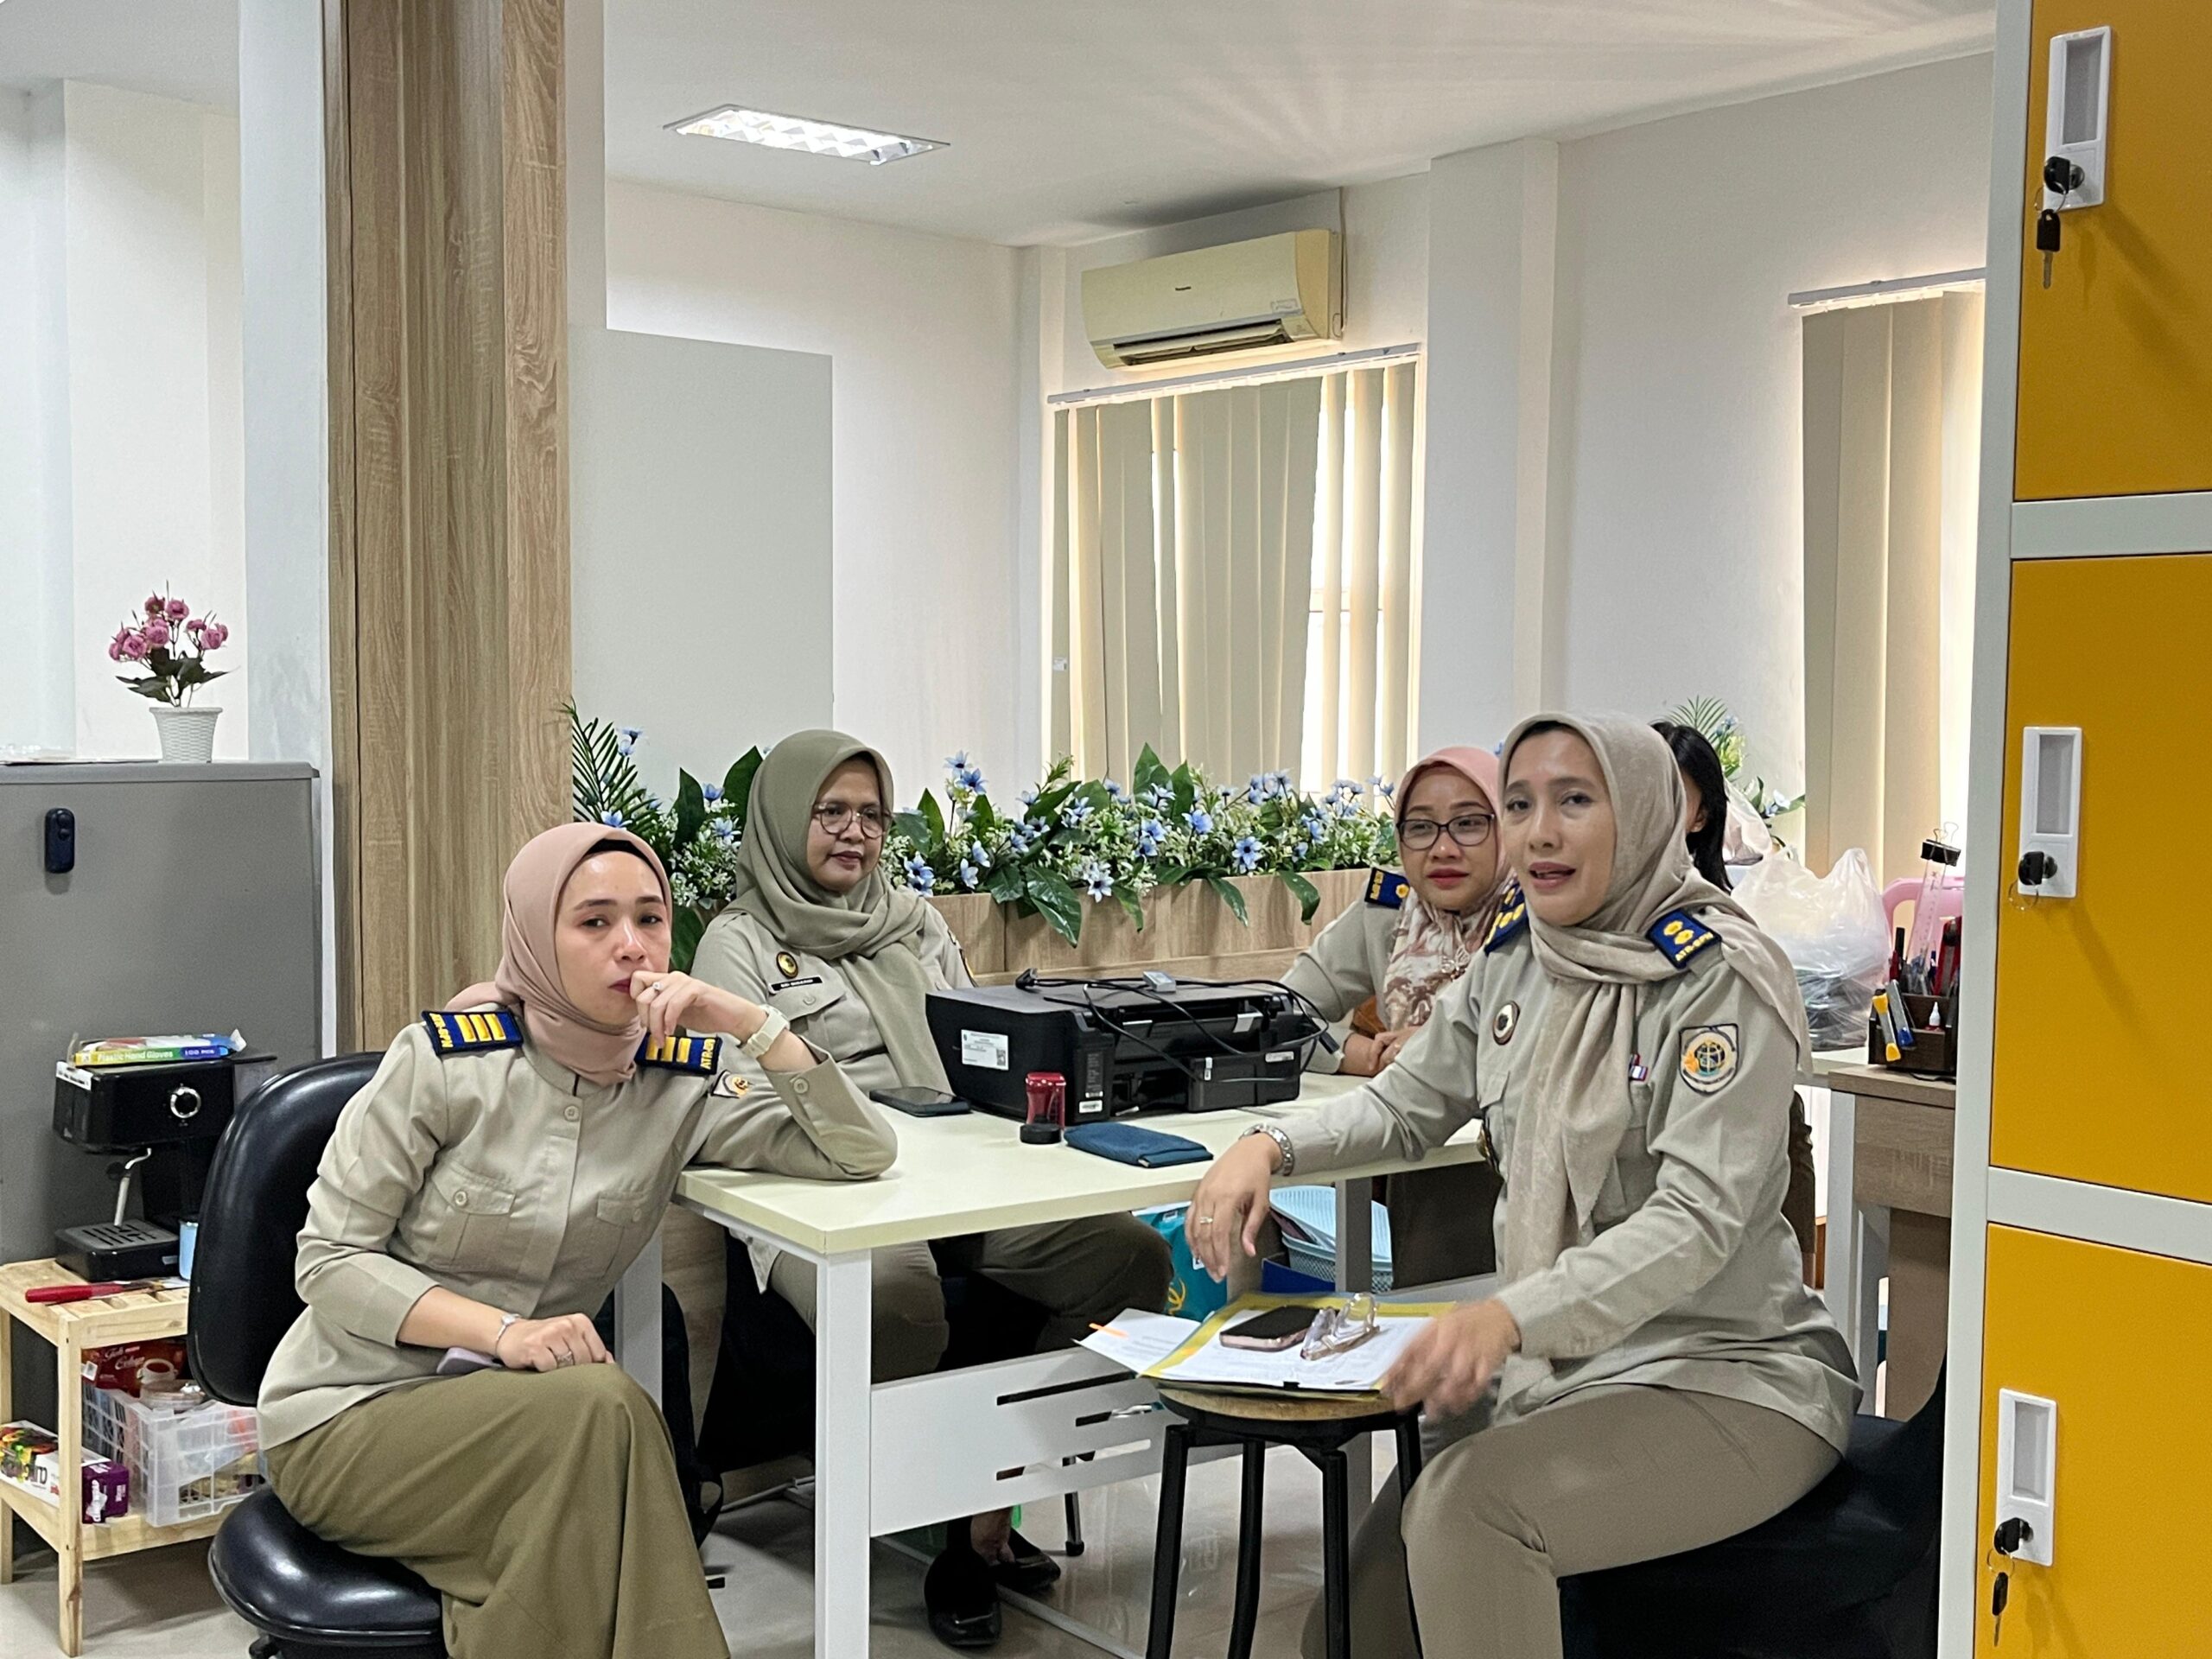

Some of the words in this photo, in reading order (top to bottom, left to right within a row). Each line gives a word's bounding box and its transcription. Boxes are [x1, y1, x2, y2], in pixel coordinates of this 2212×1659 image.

[124, 1051, 145, 1060] Hand
[146, 1049, 174, 1059] Gloves
[184, 1048, 200, 1057] 100
